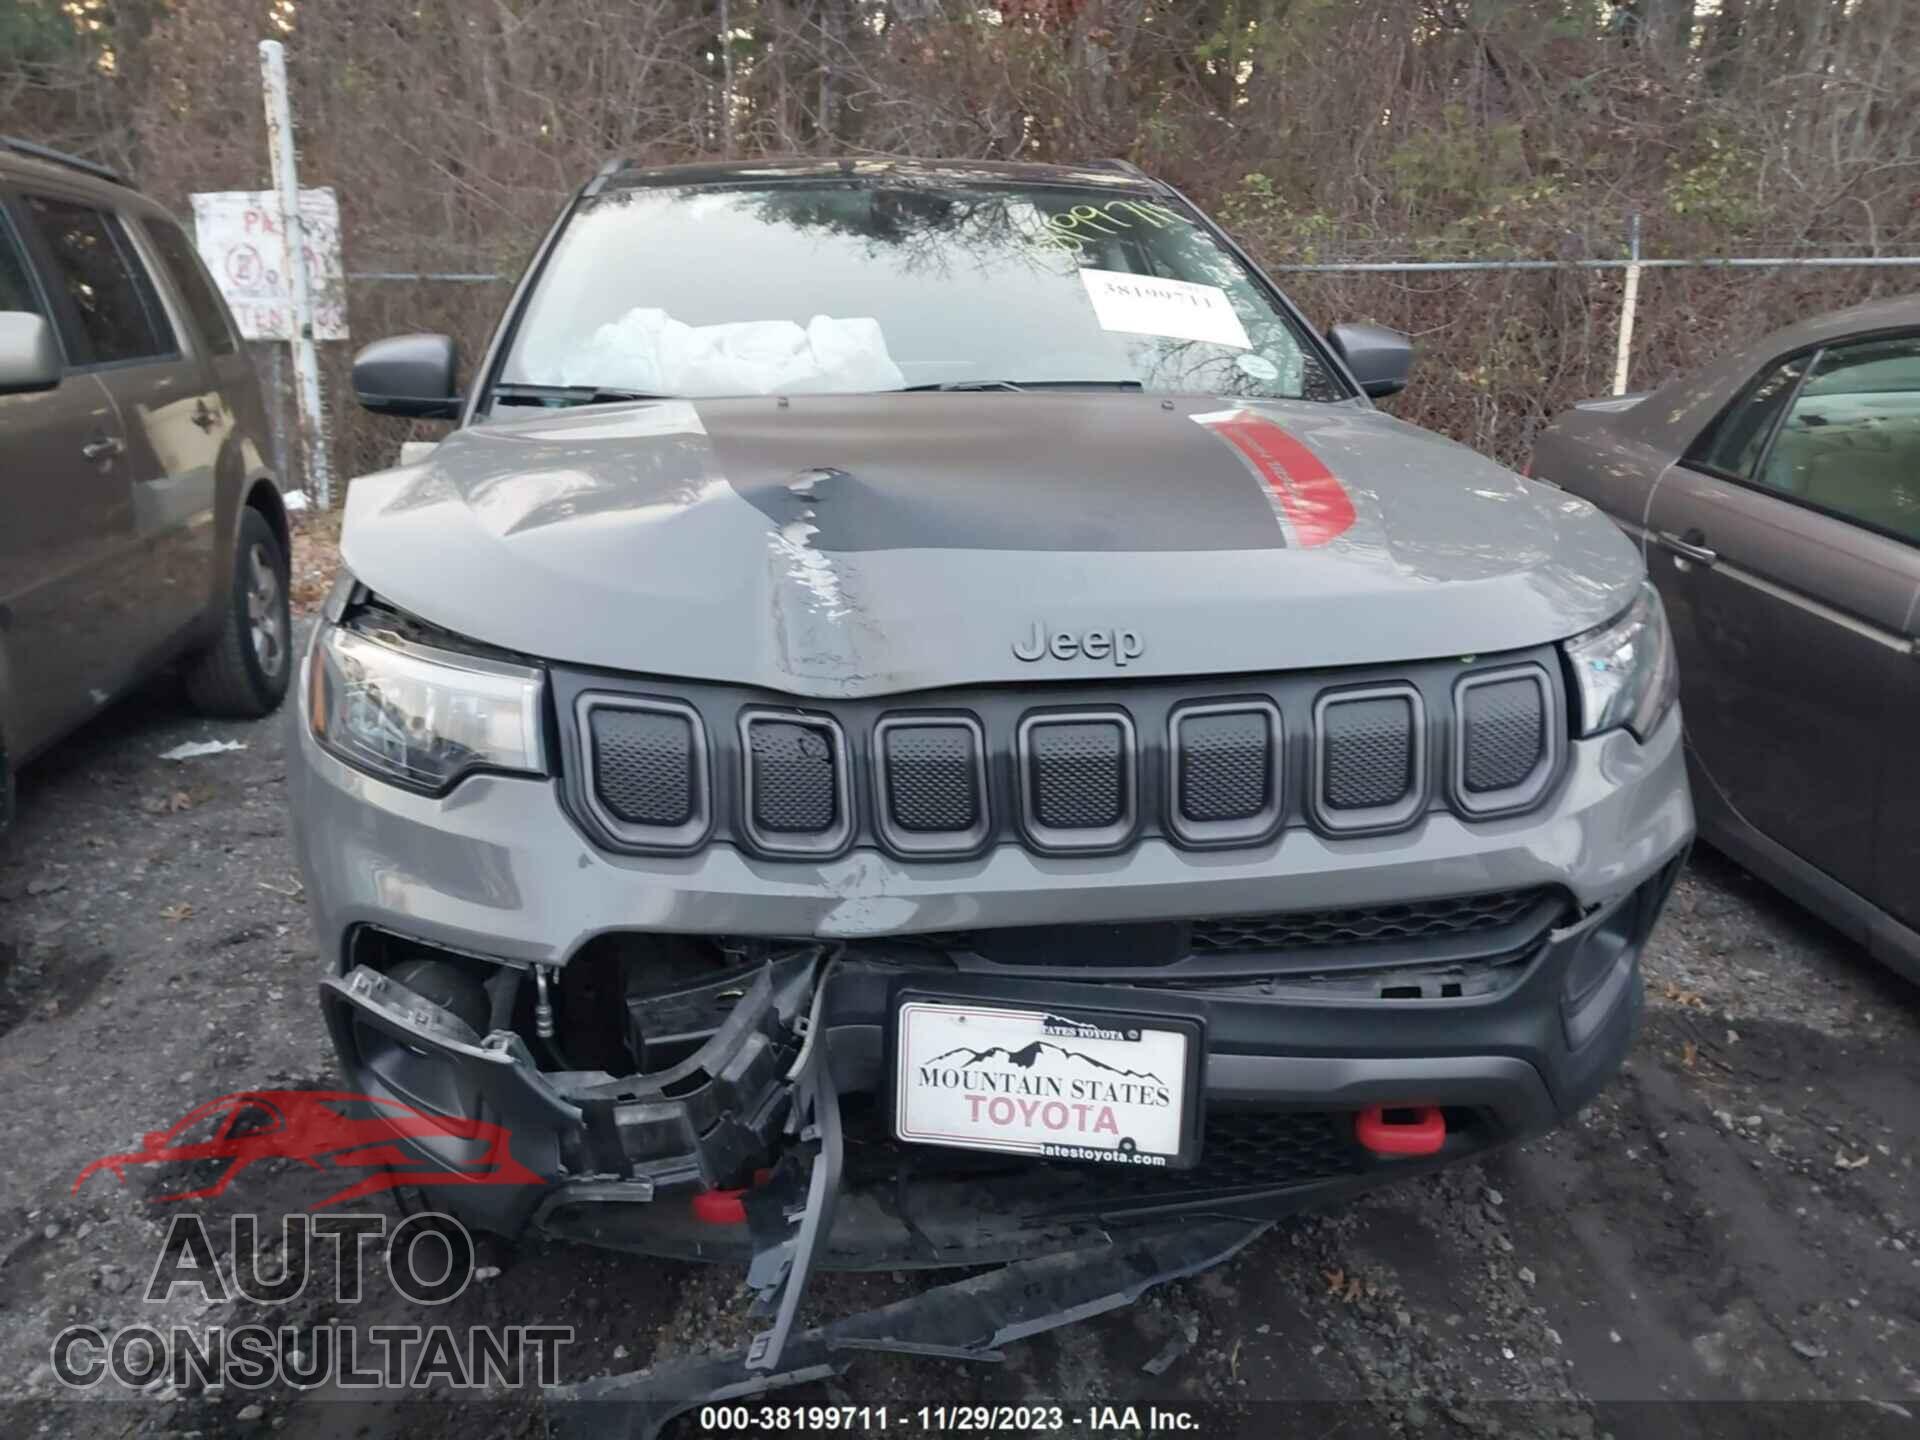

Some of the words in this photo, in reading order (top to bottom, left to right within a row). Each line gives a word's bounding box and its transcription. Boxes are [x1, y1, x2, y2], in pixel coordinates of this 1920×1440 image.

[1012, 619, 1145, 667] Jeep
[1080, 1028, 1125, 1041] TOYOTA
[919, 1067, 1063, 1097] MOUNTAIN
[1071, 1079, 1171, 1107] STATES
[965, 1095, 1119, 1135] TOYOTA
